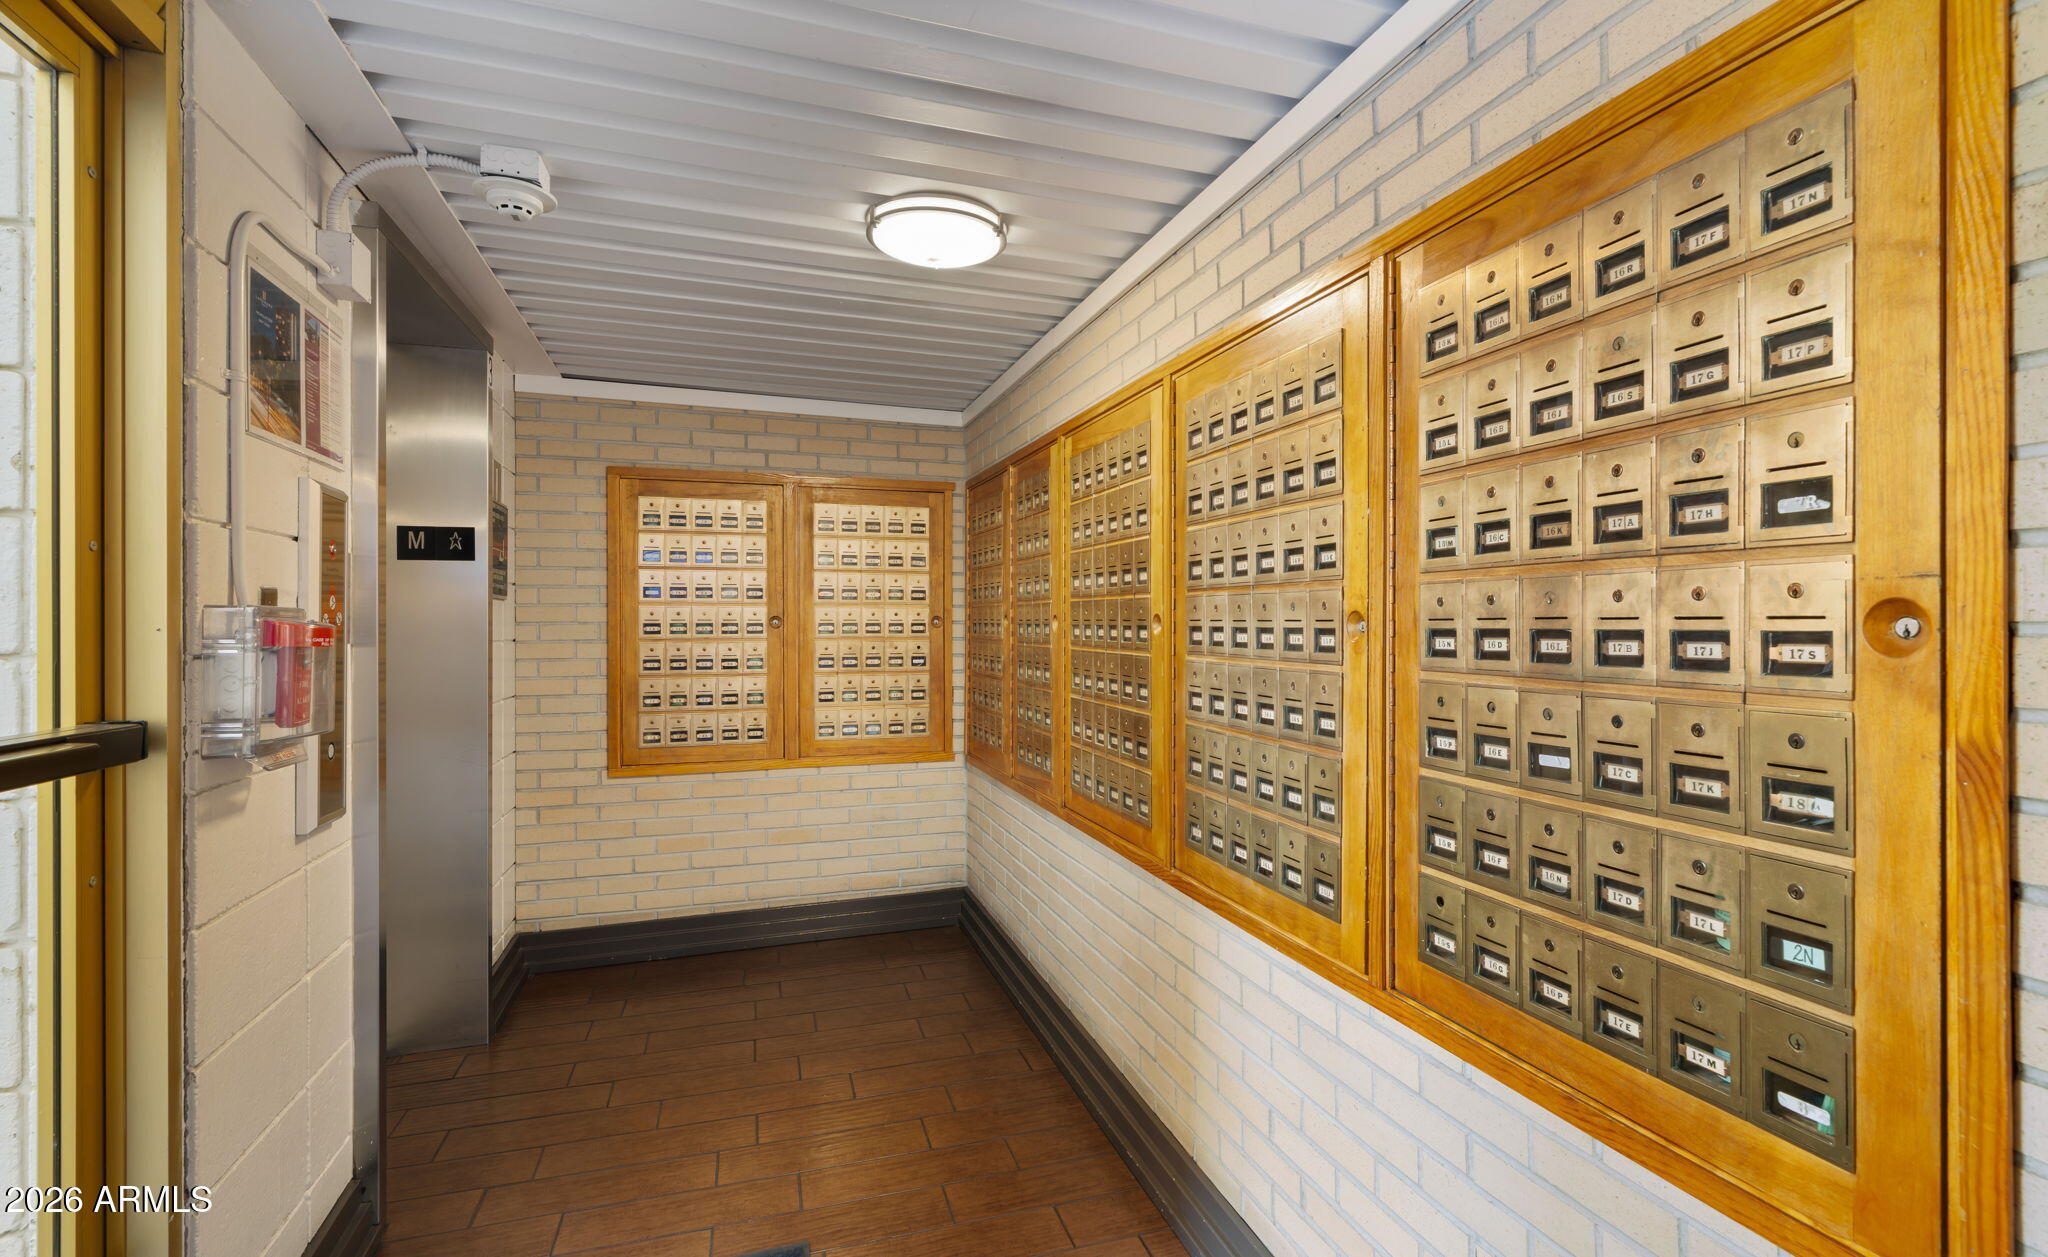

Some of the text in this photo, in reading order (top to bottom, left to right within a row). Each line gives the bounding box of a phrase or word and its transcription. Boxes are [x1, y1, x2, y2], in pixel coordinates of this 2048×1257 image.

[1790, 190, 1818, 211] 17N
[1694, 231, 1717, 248] 17F
[1613, 264, 1633, 280] 16R
[1544, 293, 1563, 306] 16H
[1489, 316, 1505, 328] 16A
[1787, 344, 1815, 360] 17P
[1691, 371, 1714, 385] 17G
[1610, 391, 1633, 404] 16S
[1489, 425, 1504, 436] 16B
[1690, 509, 1713, 520] 17H
[1611, 518, 1634, 528] 17A
[408, 531, 424, 549] M
[1489, 533, 1504, 542] 16C
[1487, 640, 1502, 649] 16D
[1545, 641, 1563, 652] 16L
[1612, 644, 1633, 653] 17B
[1788, 648, 1816, 660] 17S
[1487, 747, 1502, 757] 16E
[1612, 767, 1632, 779] 17C
[1691, 780, 1714, 795] 17K
[1487, 853, 1502, 865] 16F
[1545, 871, 1562, 884] 16N
[1612, 891, 1632, 906] 17D
[1693, 917, 1715, 932] 17L
[1793, 944, 1814, 966] 2N
[1488, 960, 1503, 973] 16G
[1546, 985, 1563, 999] 16P
[1612, 1016, 1632, 1033] 17E
[1692, 1050, 1717, 1069] 17M
